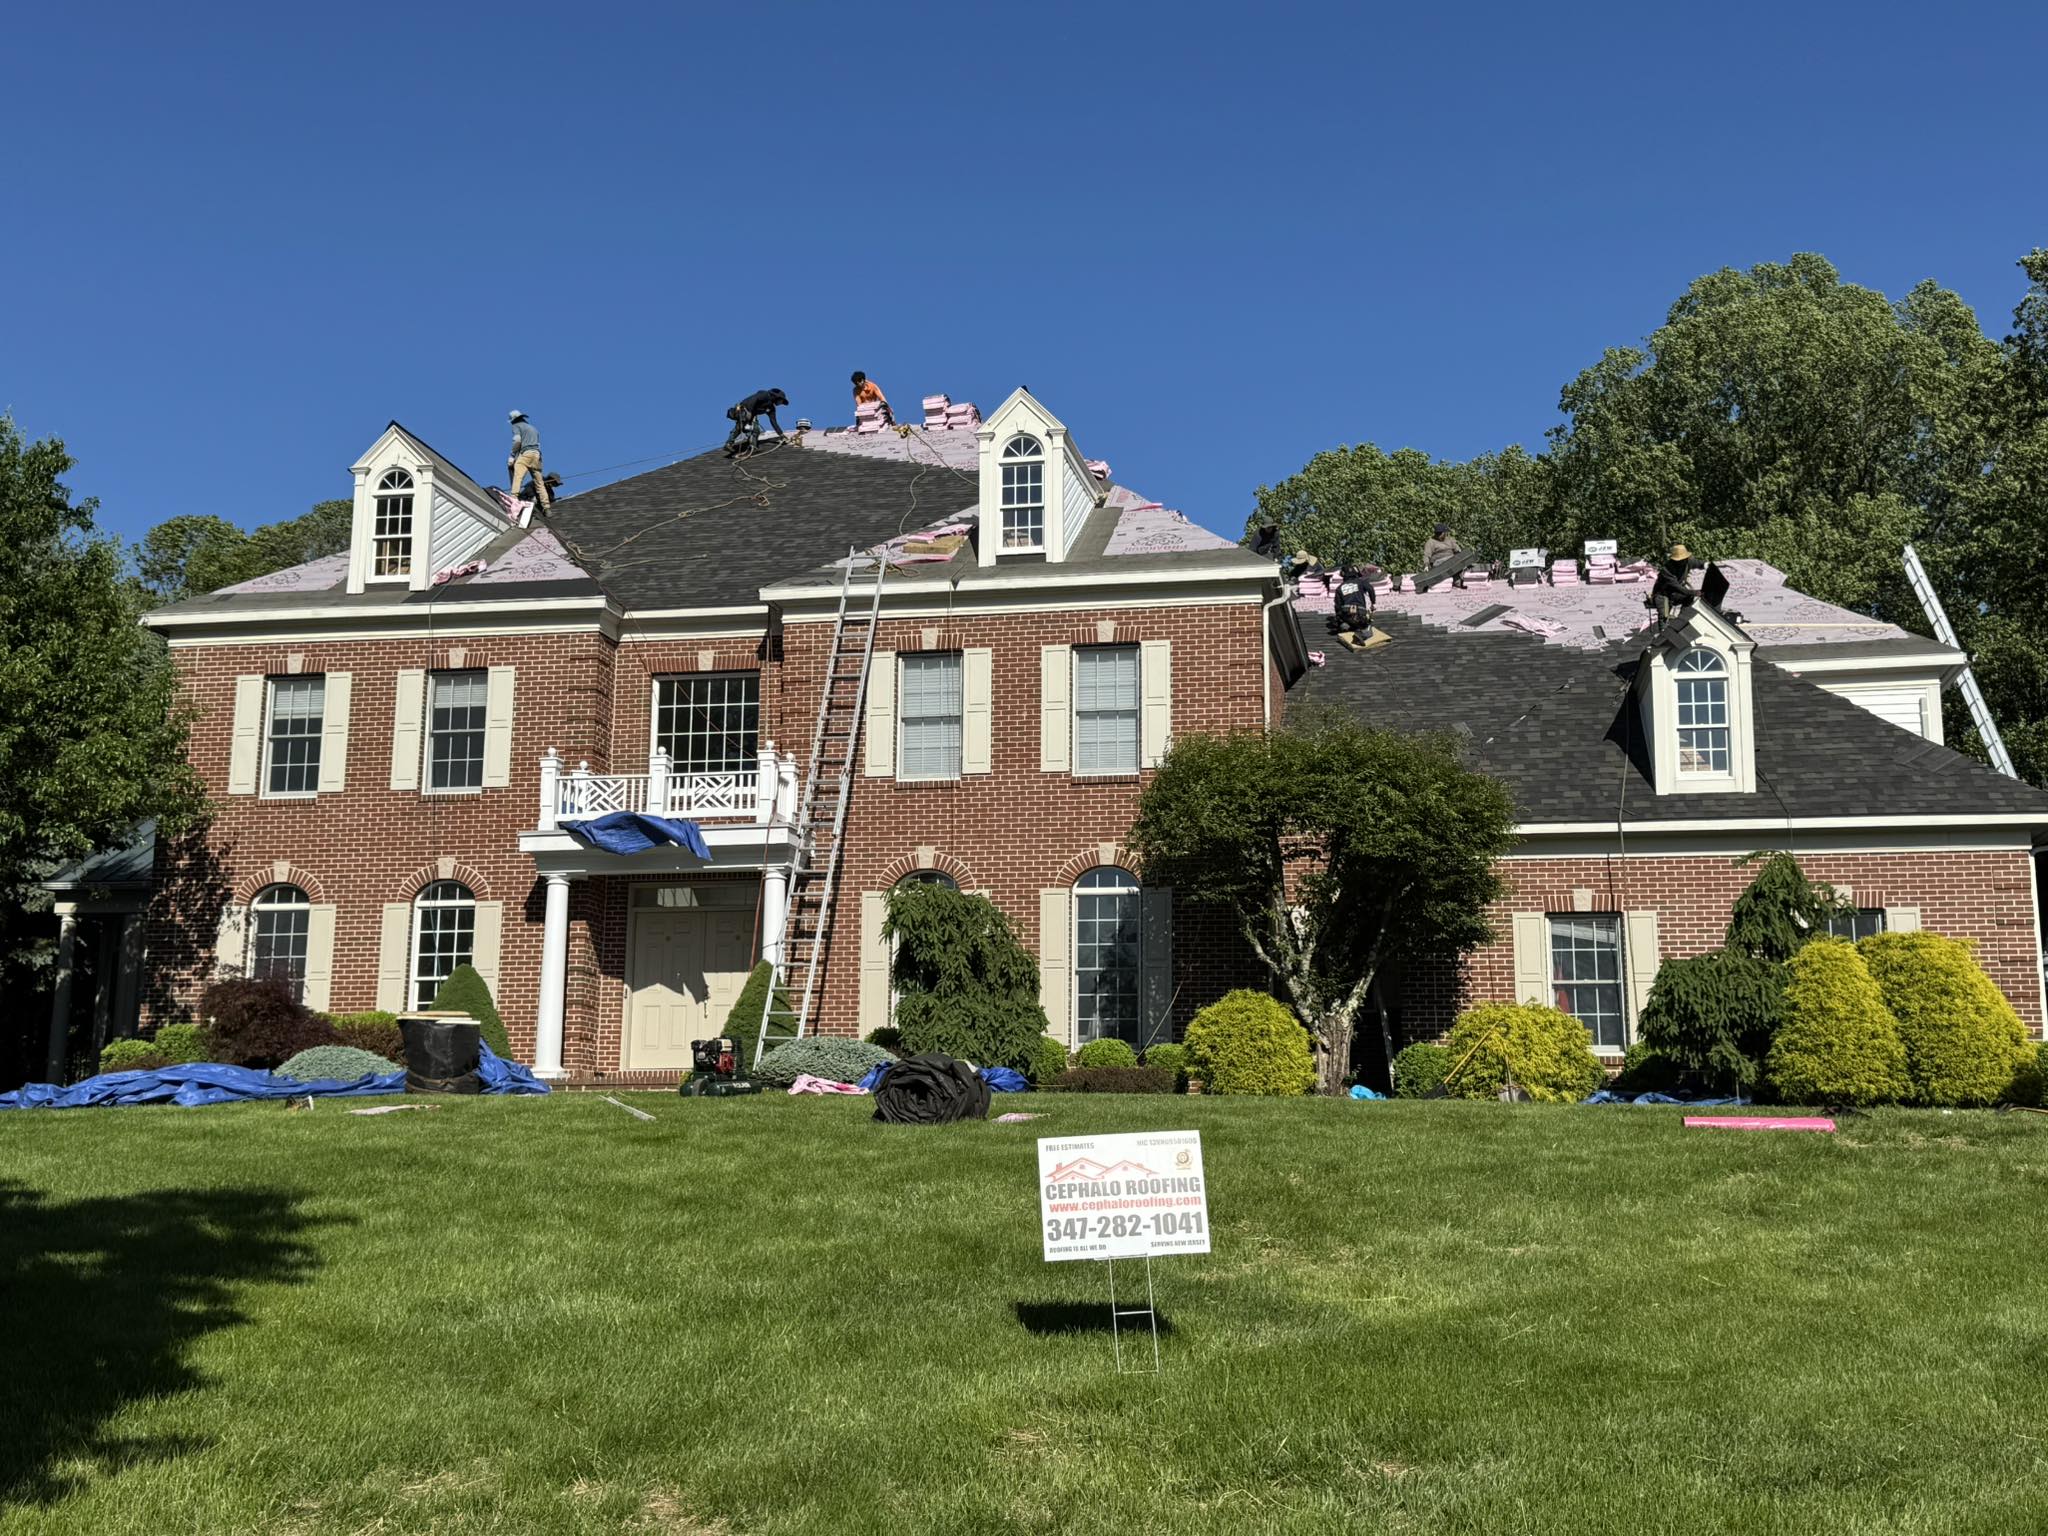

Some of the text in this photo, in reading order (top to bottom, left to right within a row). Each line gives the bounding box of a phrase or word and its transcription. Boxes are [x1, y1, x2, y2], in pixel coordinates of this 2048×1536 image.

[1046, 1142, 1095, 1152] FREE ESTIMATES
[1045, 1176, 1201, 1200] CEPHALO ROOFING
[1049, 1195, 1202, 1213] www.cephaloroofing.com
[1047, 1211, 1203, 1242] 347-282-1041
